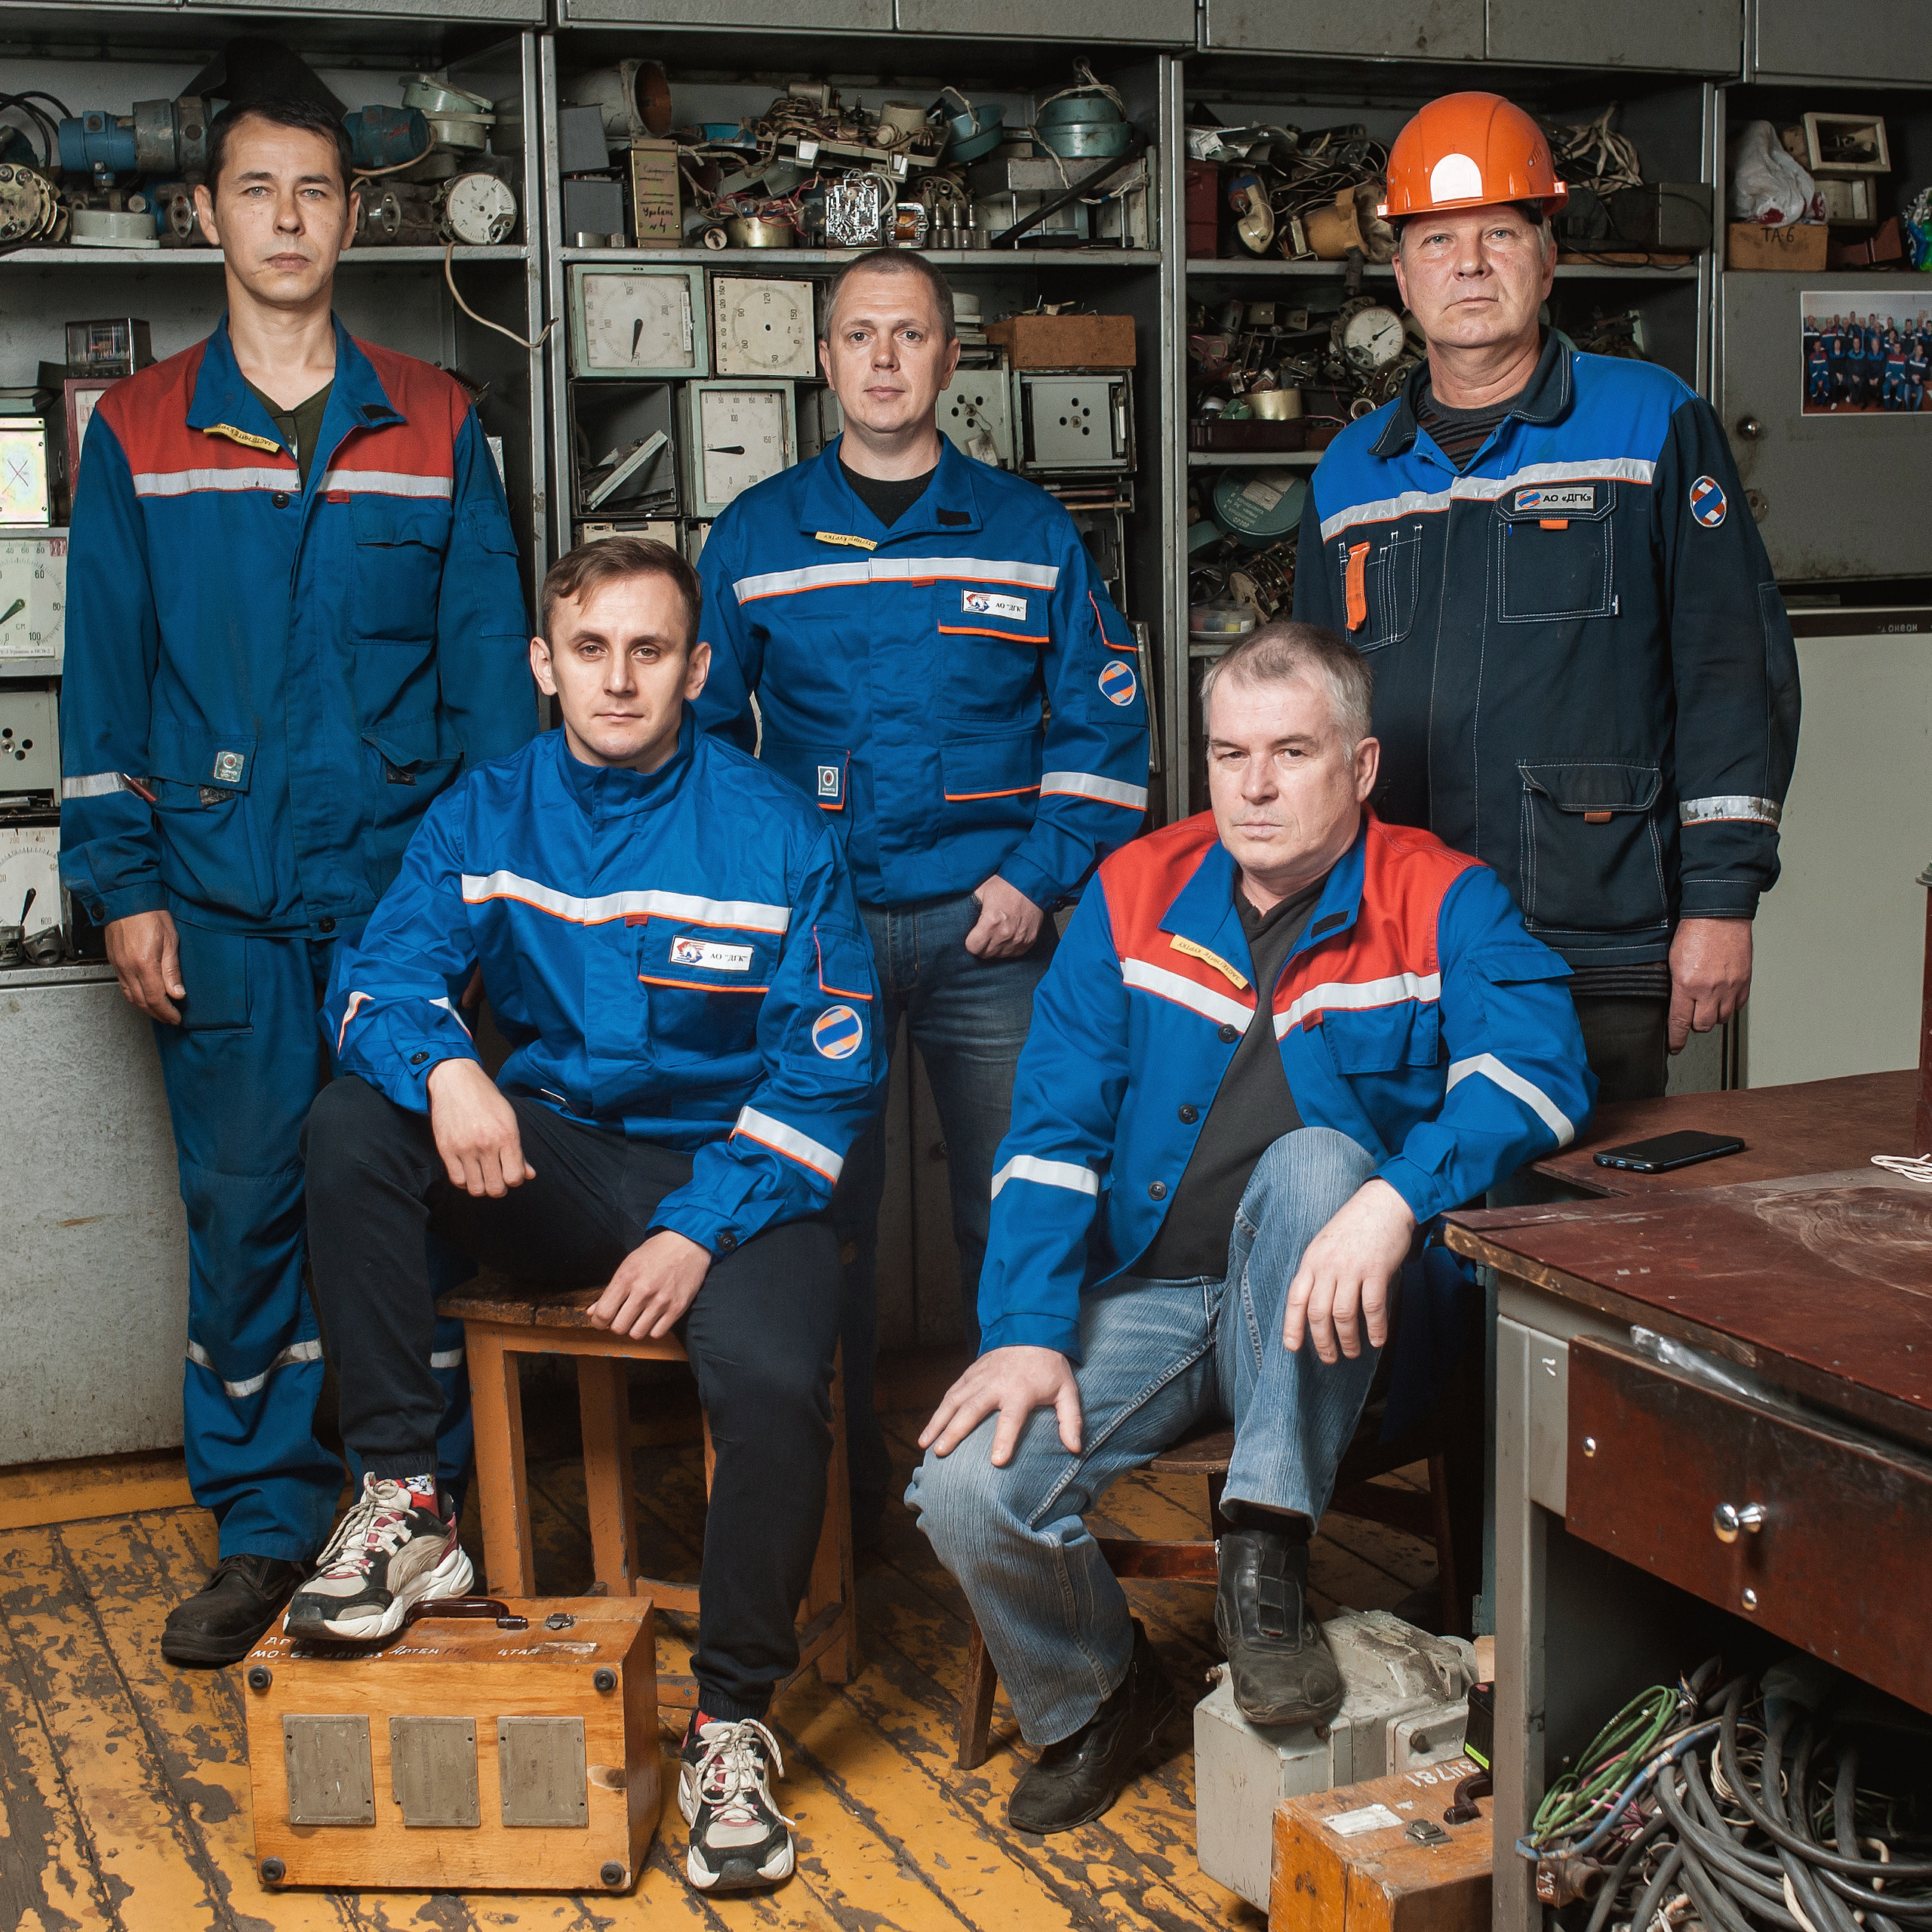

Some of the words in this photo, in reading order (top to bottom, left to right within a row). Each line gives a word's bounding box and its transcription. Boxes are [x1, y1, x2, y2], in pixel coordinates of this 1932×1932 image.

[35, 570, 45, 579] 60
[29, 632, 41, 641] 100
[1204, 952, 1241, 980] ЗАСТЕГНИТЕ
